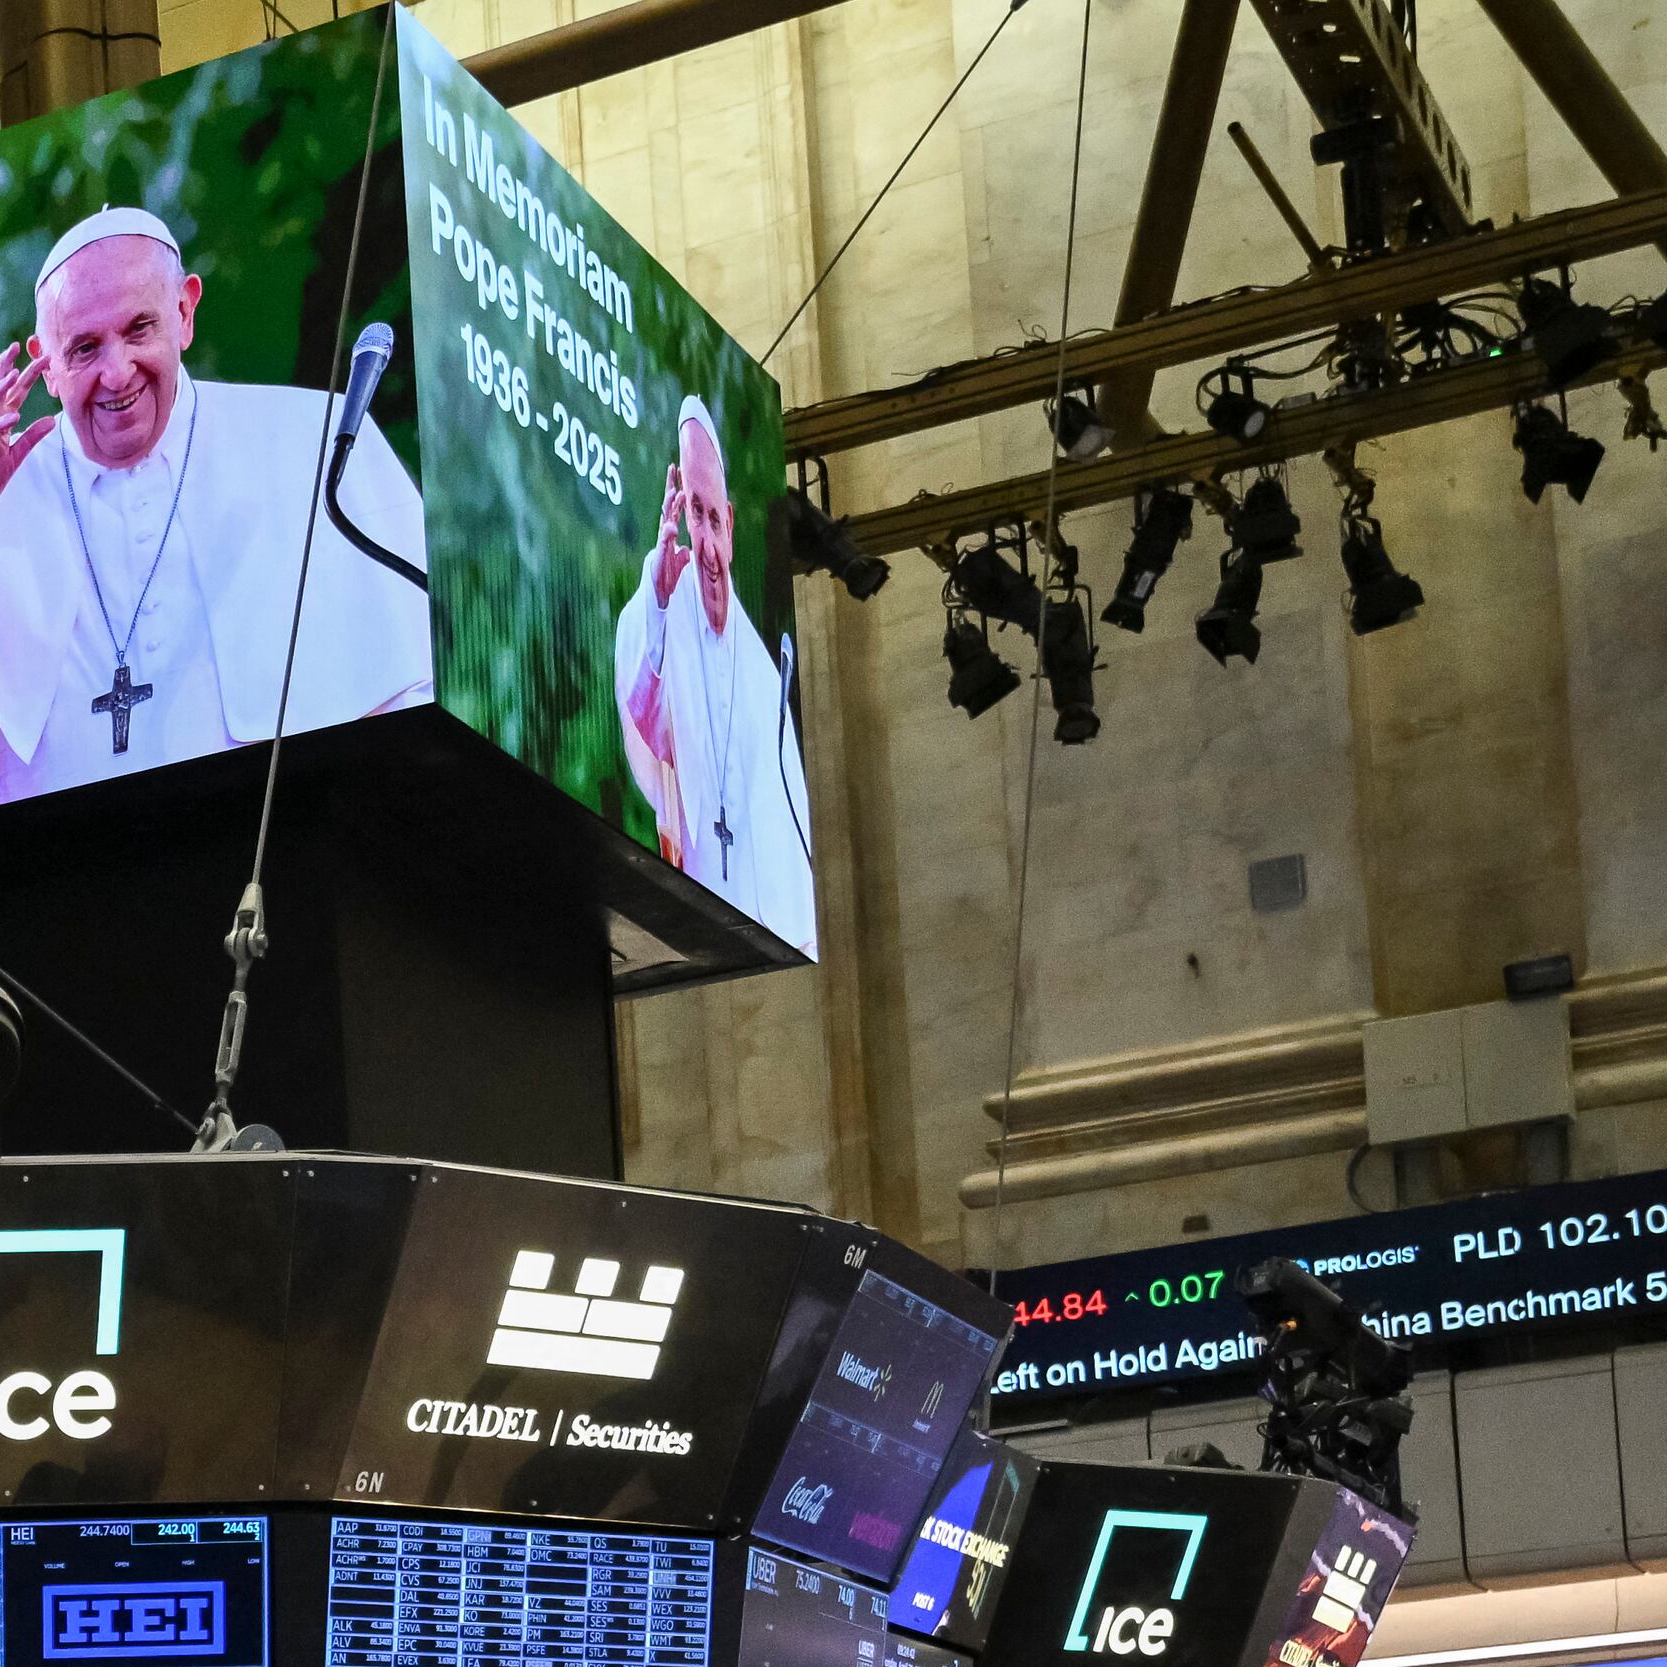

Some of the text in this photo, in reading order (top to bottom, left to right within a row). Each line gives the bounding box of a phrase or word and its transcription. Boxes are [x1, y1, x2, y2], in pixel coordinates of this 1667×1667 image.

[421, 78, 635, 334] In Memoriam
[427, 198, 639, 430] Pope Francis
[460, 322, 624, 507] 1936 2025
[843, 1243, 867, 1270] 6M
[1149, 1269, 1225, 1307] 0.07
[1314, 1246, 1416, 1276] PROLOGIS
[1453, 1226, 1522, 1263] PLD
[1539, 1203, 1667, 1250] 102.10
[990, 1361, 1040, 1395] eft
[1046, 1359, 1086, 1387] on
[1094, 1342, 1167, 1380] Hold
[1361, 1310, 1432, 1339] hina
[1440, 1277, 1637, 1331] Benchmark
[836, 1350, 880, 1391] Walmart
[406, 1398, 693, 1456] CITADEL Securities
[354, 1470, 384, 1494] 6N
[752, 1555, 776, 1585] UBER
[58, 1597, 210, 1643] HEI
